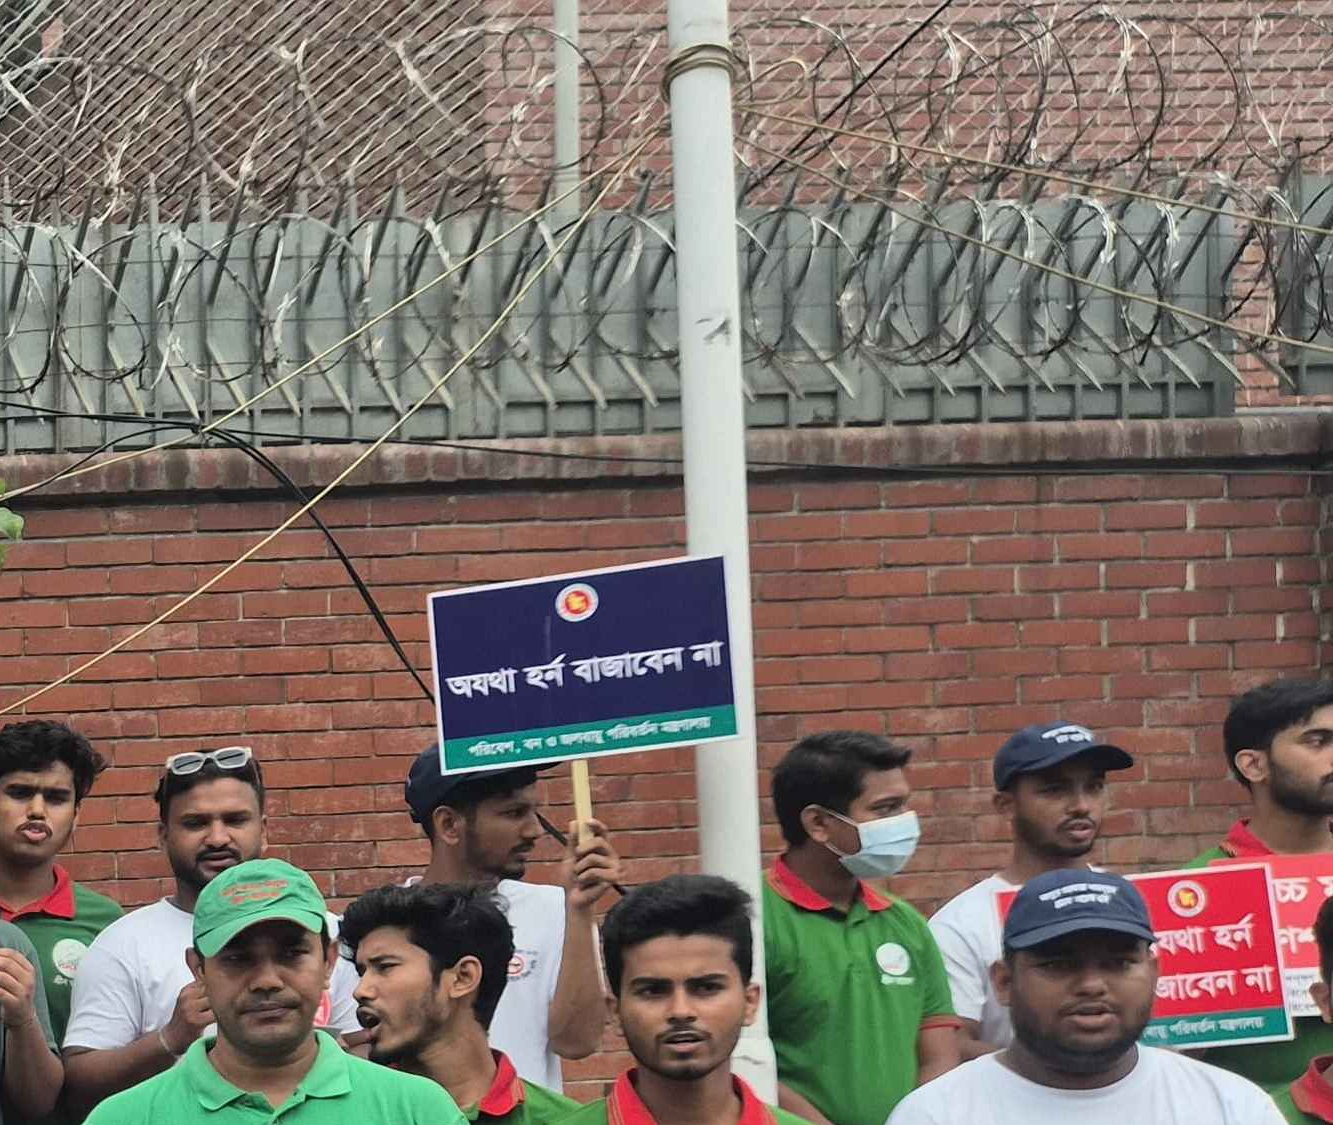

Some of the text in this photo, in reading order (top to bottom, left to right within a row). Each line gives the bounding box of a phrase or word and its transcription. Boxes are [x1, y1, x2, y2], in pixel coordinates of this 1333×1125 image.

[446, 640, 723, 698] অযথা হর্ন বাজাবেন না
[1274, 877, 1310, 902] চ্চ
[1211, 914, 1253, 950] হর্ন
[1155, 969, 1236, 1001] জাবেন
[1242, 965, 1275, 994] না
